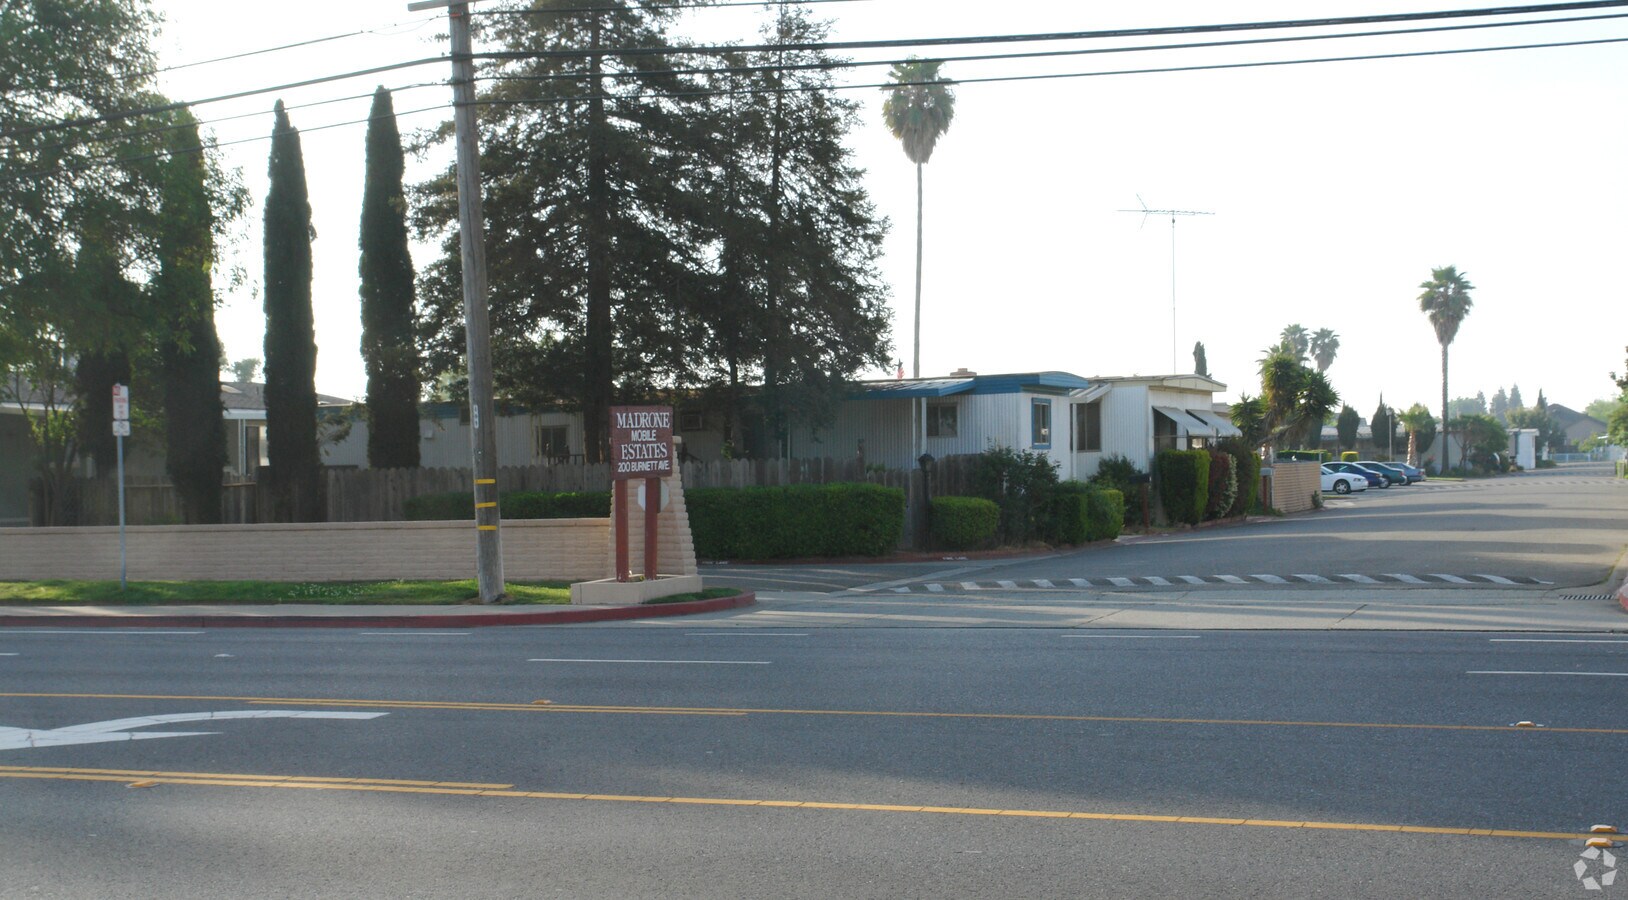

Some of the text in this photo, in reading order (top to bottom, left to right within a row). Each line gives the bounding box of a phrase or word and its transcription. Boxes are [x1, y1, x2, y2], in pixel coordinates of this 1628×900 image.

[616, 412, 670, 428] MADRONE
[631, 430, 657, 441] MOBILE
[621, 443, 668, 460] ESTATES
[617, 461, 630, 472] 200
[631, 460, 658, 471] BURNETT
